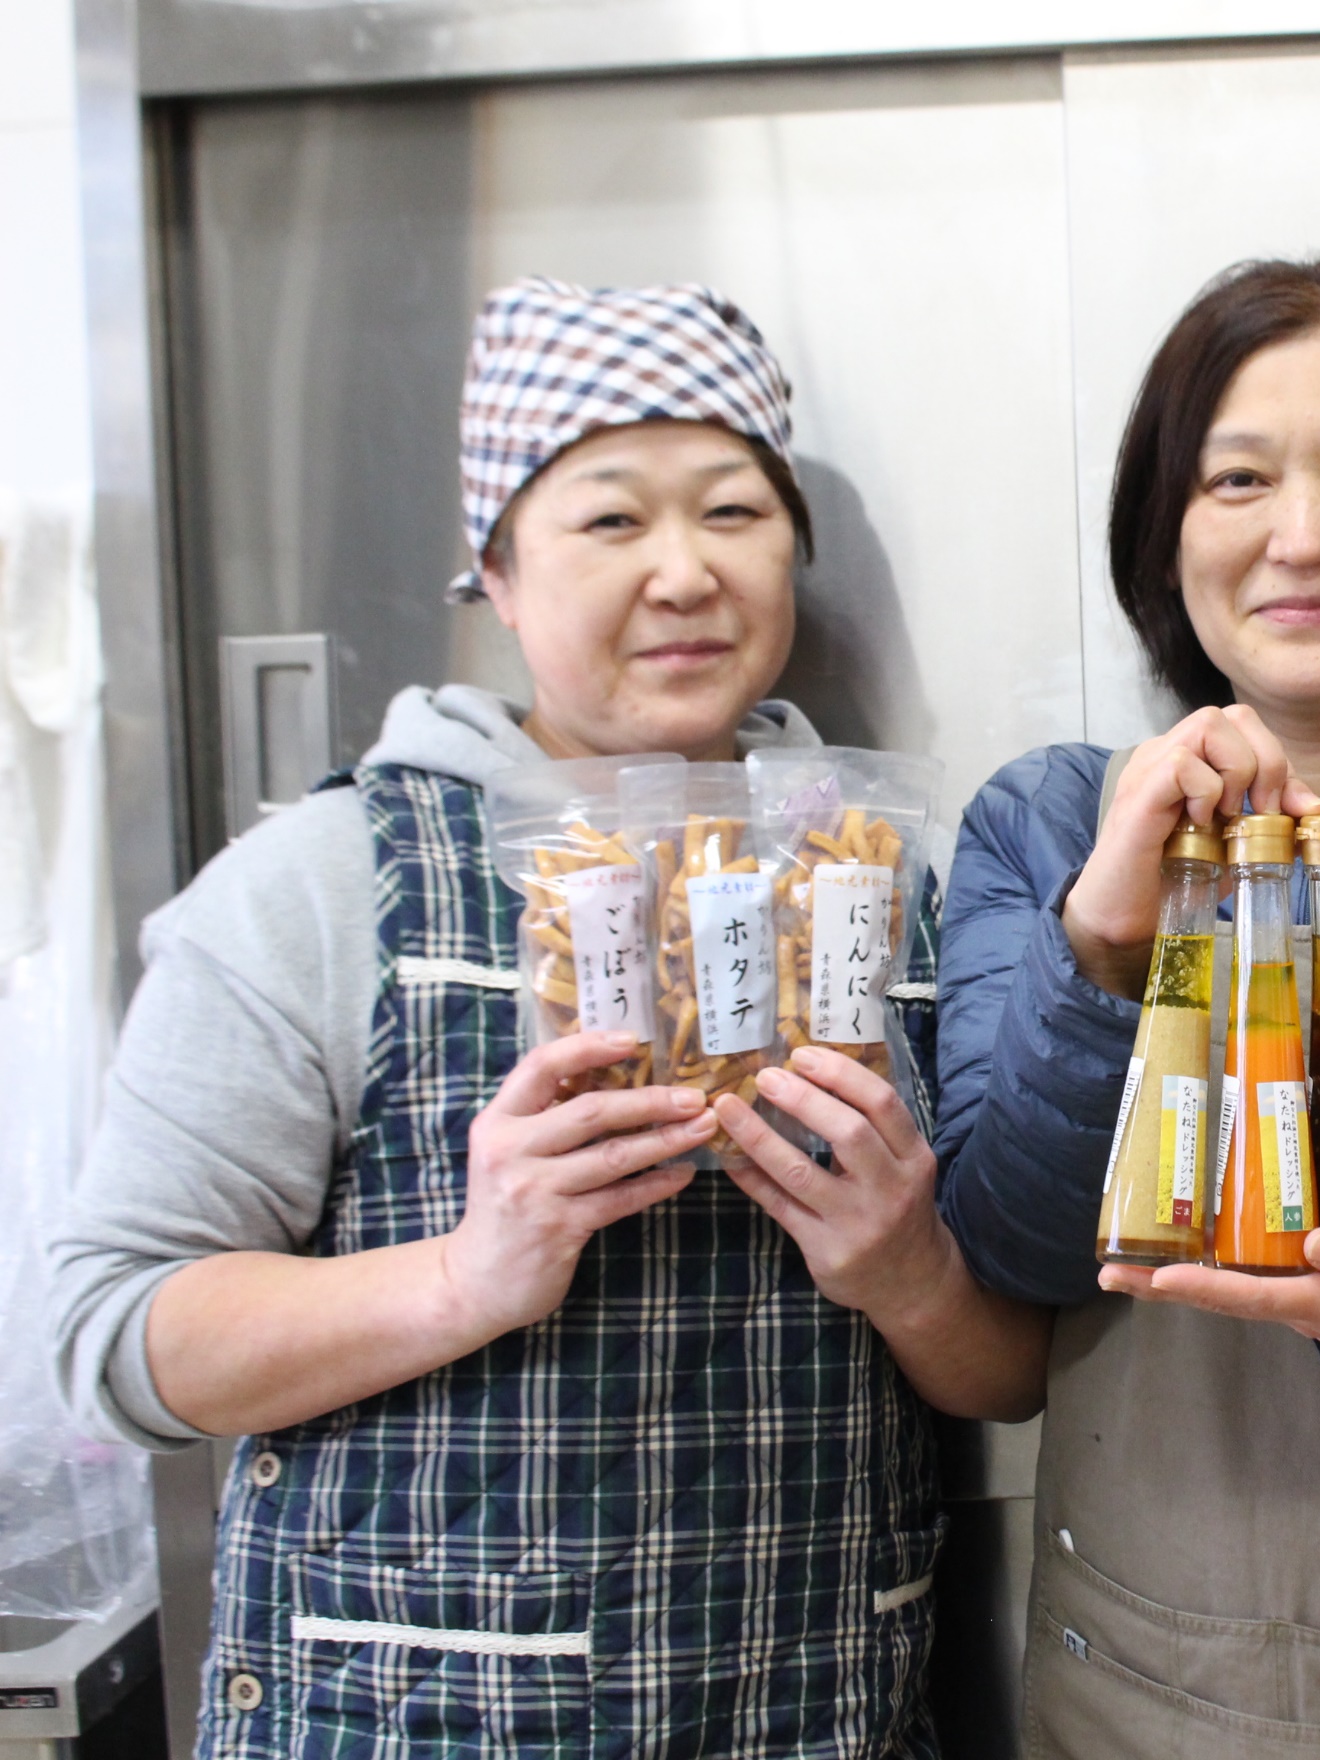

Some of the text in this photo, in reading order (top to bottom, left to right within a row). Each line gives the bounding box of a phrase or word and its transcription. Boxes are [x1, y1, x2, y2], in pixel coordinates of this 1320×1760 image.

[604, 904, 632, 1020] ごぼう
[723, 917, 754, 1031] ホタテ
[817, 953, 832, 1038] 青森県横浜町
[848, 904, 870, 1036] にんにく
[1179, 1085, 1192, 1196] なたねドレッシング
[1280, 1089, 1295, 1201] なたねドレッシング
[1175, 1206, 1190, 1216] ごま
